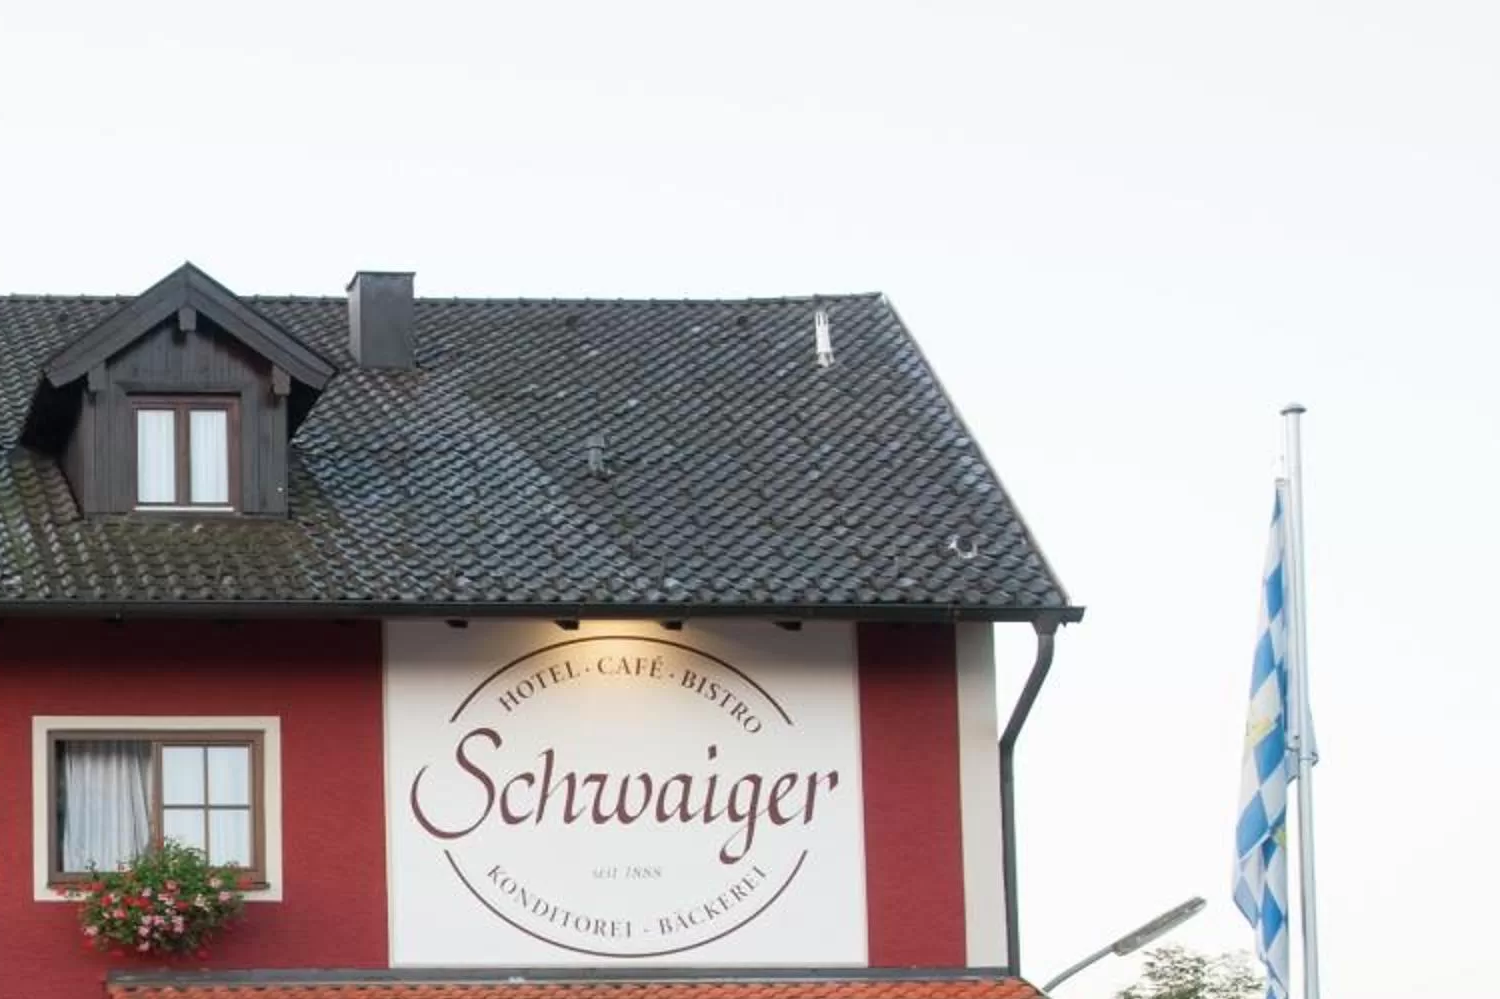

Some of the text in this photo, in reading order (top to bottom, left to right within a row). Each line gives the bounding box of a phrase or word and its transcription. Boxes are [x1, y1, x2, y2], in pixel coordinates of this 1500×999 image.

[498, 656, 763, 735] HOTEL CAFÉ BISTRO
[410, 727, 840, 865] Schwaiger
[486, 863, 770, 939] KONDITOREI BÄCKEREI
